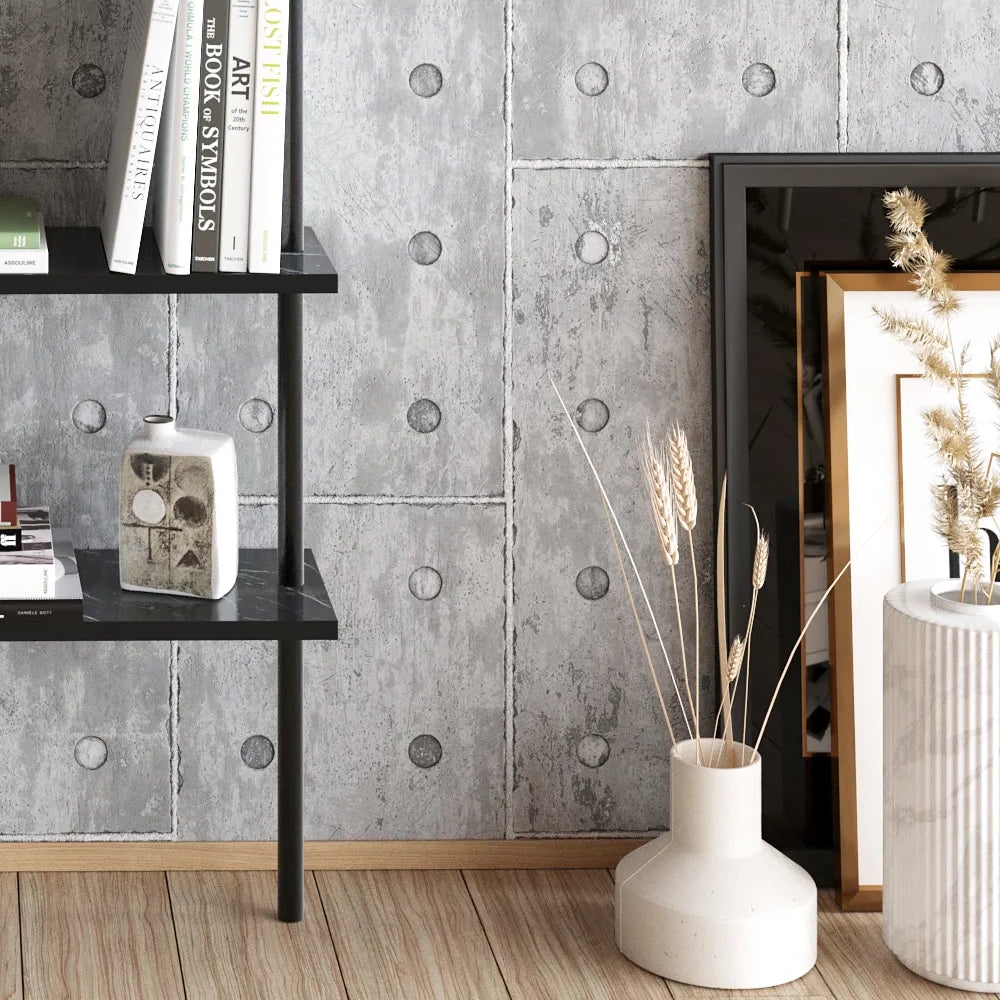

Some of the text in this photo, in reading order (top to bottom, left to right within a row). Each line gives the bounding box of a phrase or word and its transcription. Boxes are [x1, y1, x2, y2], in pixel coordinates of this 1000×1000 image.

[184, 52, 193, 84] WORLD
[231, 56, 251, 100] ART
[260, 63, 281, 115] FISH
[131, 64, 164, 201] ANTIQUAIRES
[181, 86, 191, 142] CHAMPIONS
[198, 18, 223, 231] THE BOOK OF SYMBOLS
[228, 124, 250, 133] Century
[231, 107, 248, 115] of the
